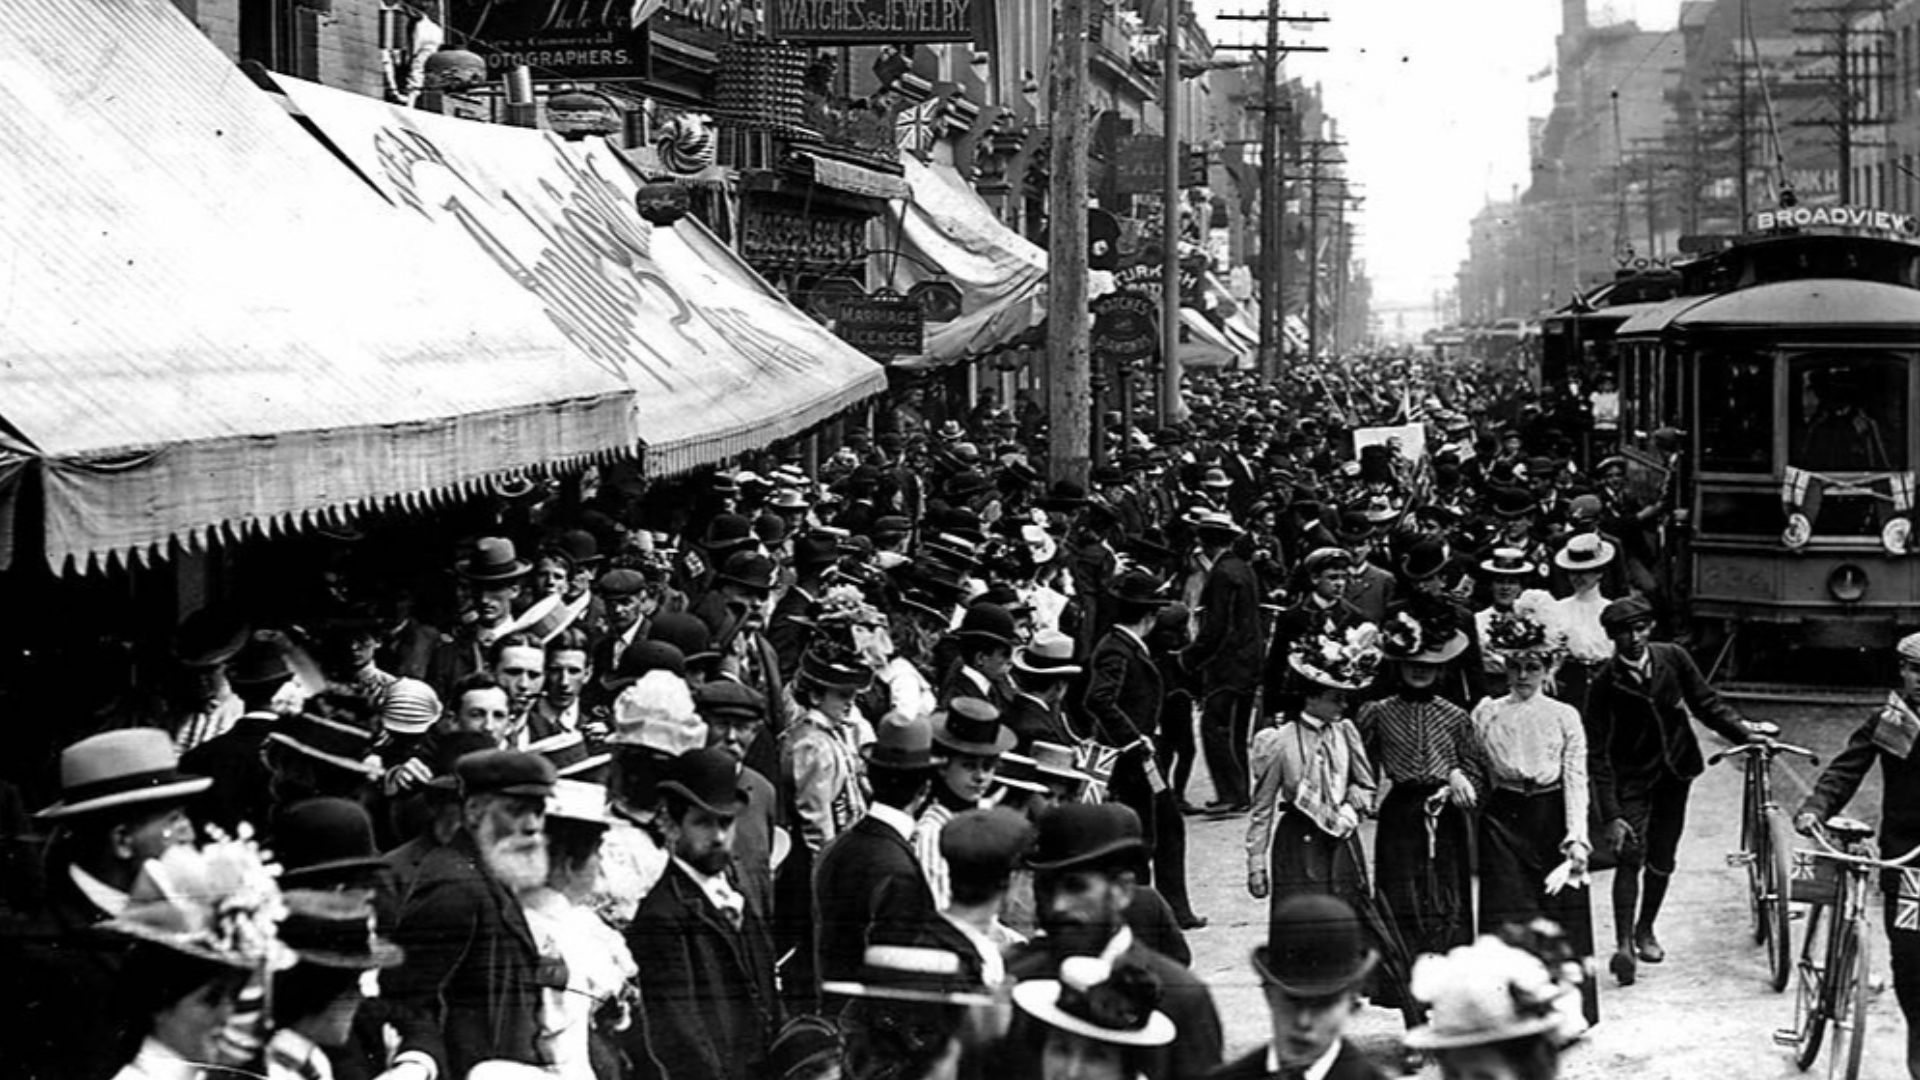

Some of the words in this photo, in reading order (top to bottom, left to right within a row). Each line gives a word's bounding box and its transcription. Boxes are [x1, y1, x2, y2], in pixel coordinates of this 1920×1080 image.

[484, 49, 633, 69] OTOGRAPHERS.
[1757, 207, 1908, 230] BROADVIEW
[1616, 255, 1685, 271] YON
[1113, 264, 1198, 289] TURKH
